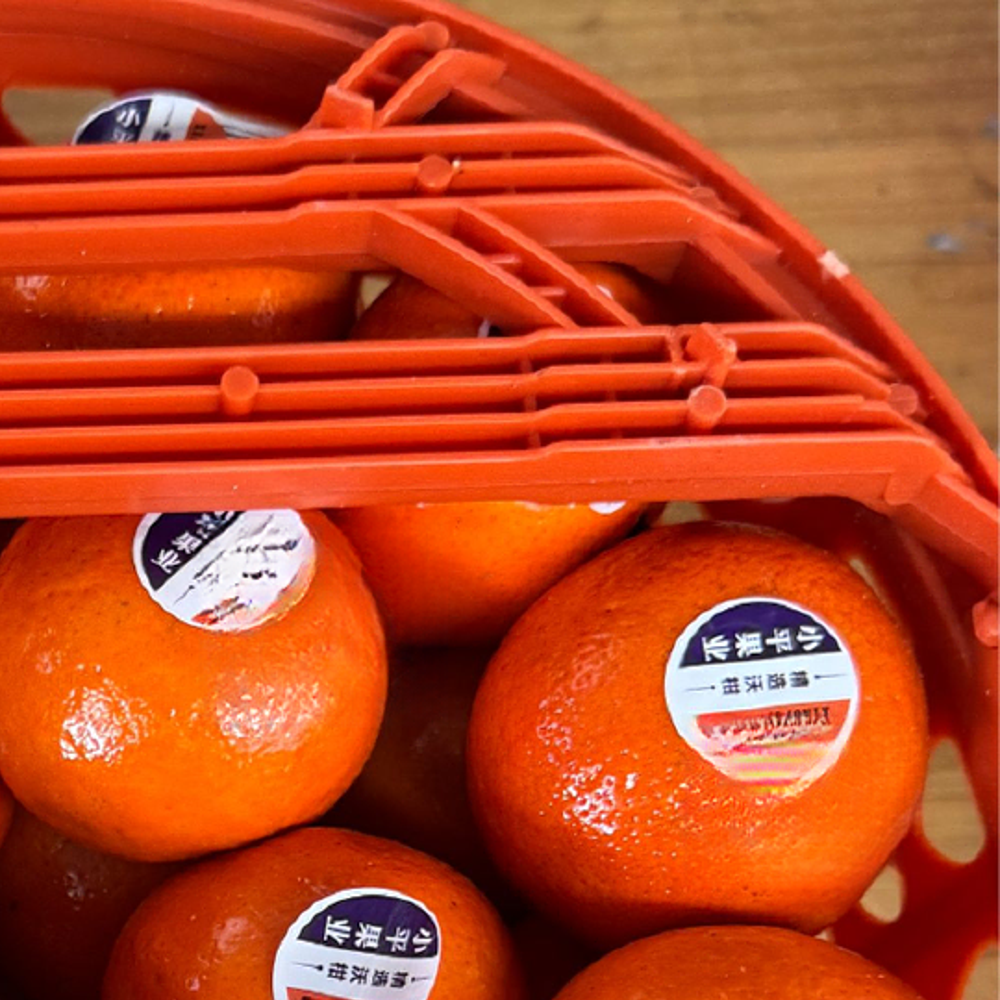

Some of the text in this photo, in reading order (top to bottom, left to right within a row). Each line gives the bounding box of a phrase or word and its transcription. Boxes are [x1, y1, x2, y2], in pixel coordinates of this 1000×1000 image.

[701, 625, 825, 662] 小平果业
[721, 670, 810, 695] 精选沃柑
[323, 915, 435, 953] 小平果业
[327, 962, 410, 989] 精选沃柑
